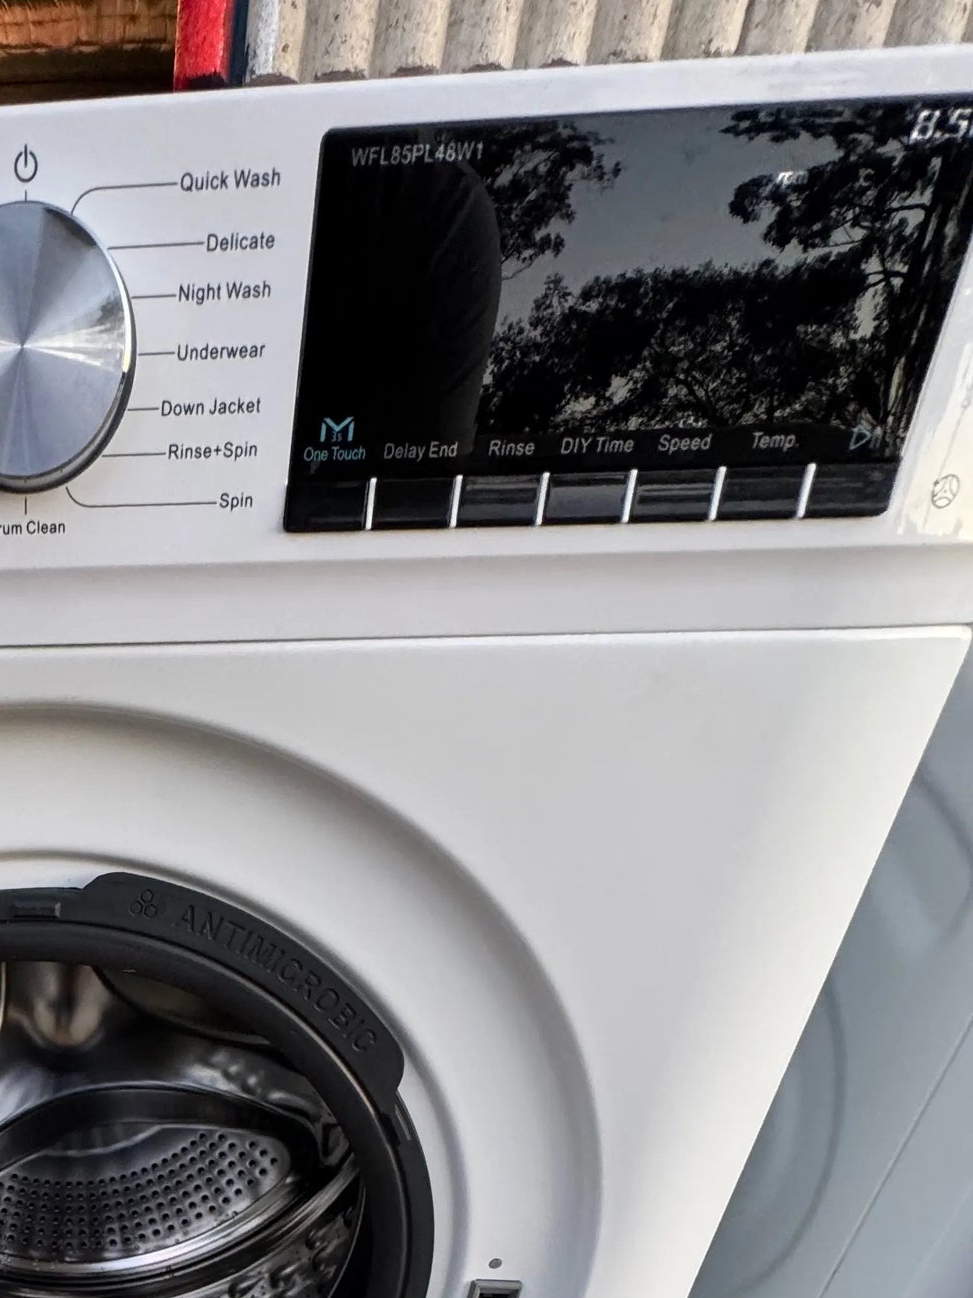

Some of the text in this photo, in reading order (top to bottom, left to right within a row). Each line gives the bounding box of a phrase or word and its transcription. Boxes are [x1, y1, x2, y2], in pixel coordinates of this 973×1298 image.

[352, 141, 484, 167] WFL85PL48W1
[180, 166, 281, 192] Quick Wash
[207, 232, 275, 252] Delicate
[178, 280, 271, 305] Night Wash
[177, 343, 266, 361] Underwear
[161, 397, 261, 416] Down Jacket
[168, 441, 258, 462] Rinse+Spin
[303, 446, 366, 462] One Touch
[383, 441, 459, 462] Delay End
[488, 439, 536, 456] Rinse
[560, 436, 635, 455] DIY Time
[658, 434, 713, 455] Speed
[219, 492, 254, 511] Spin
[26, 519, 66, 534] Clean
